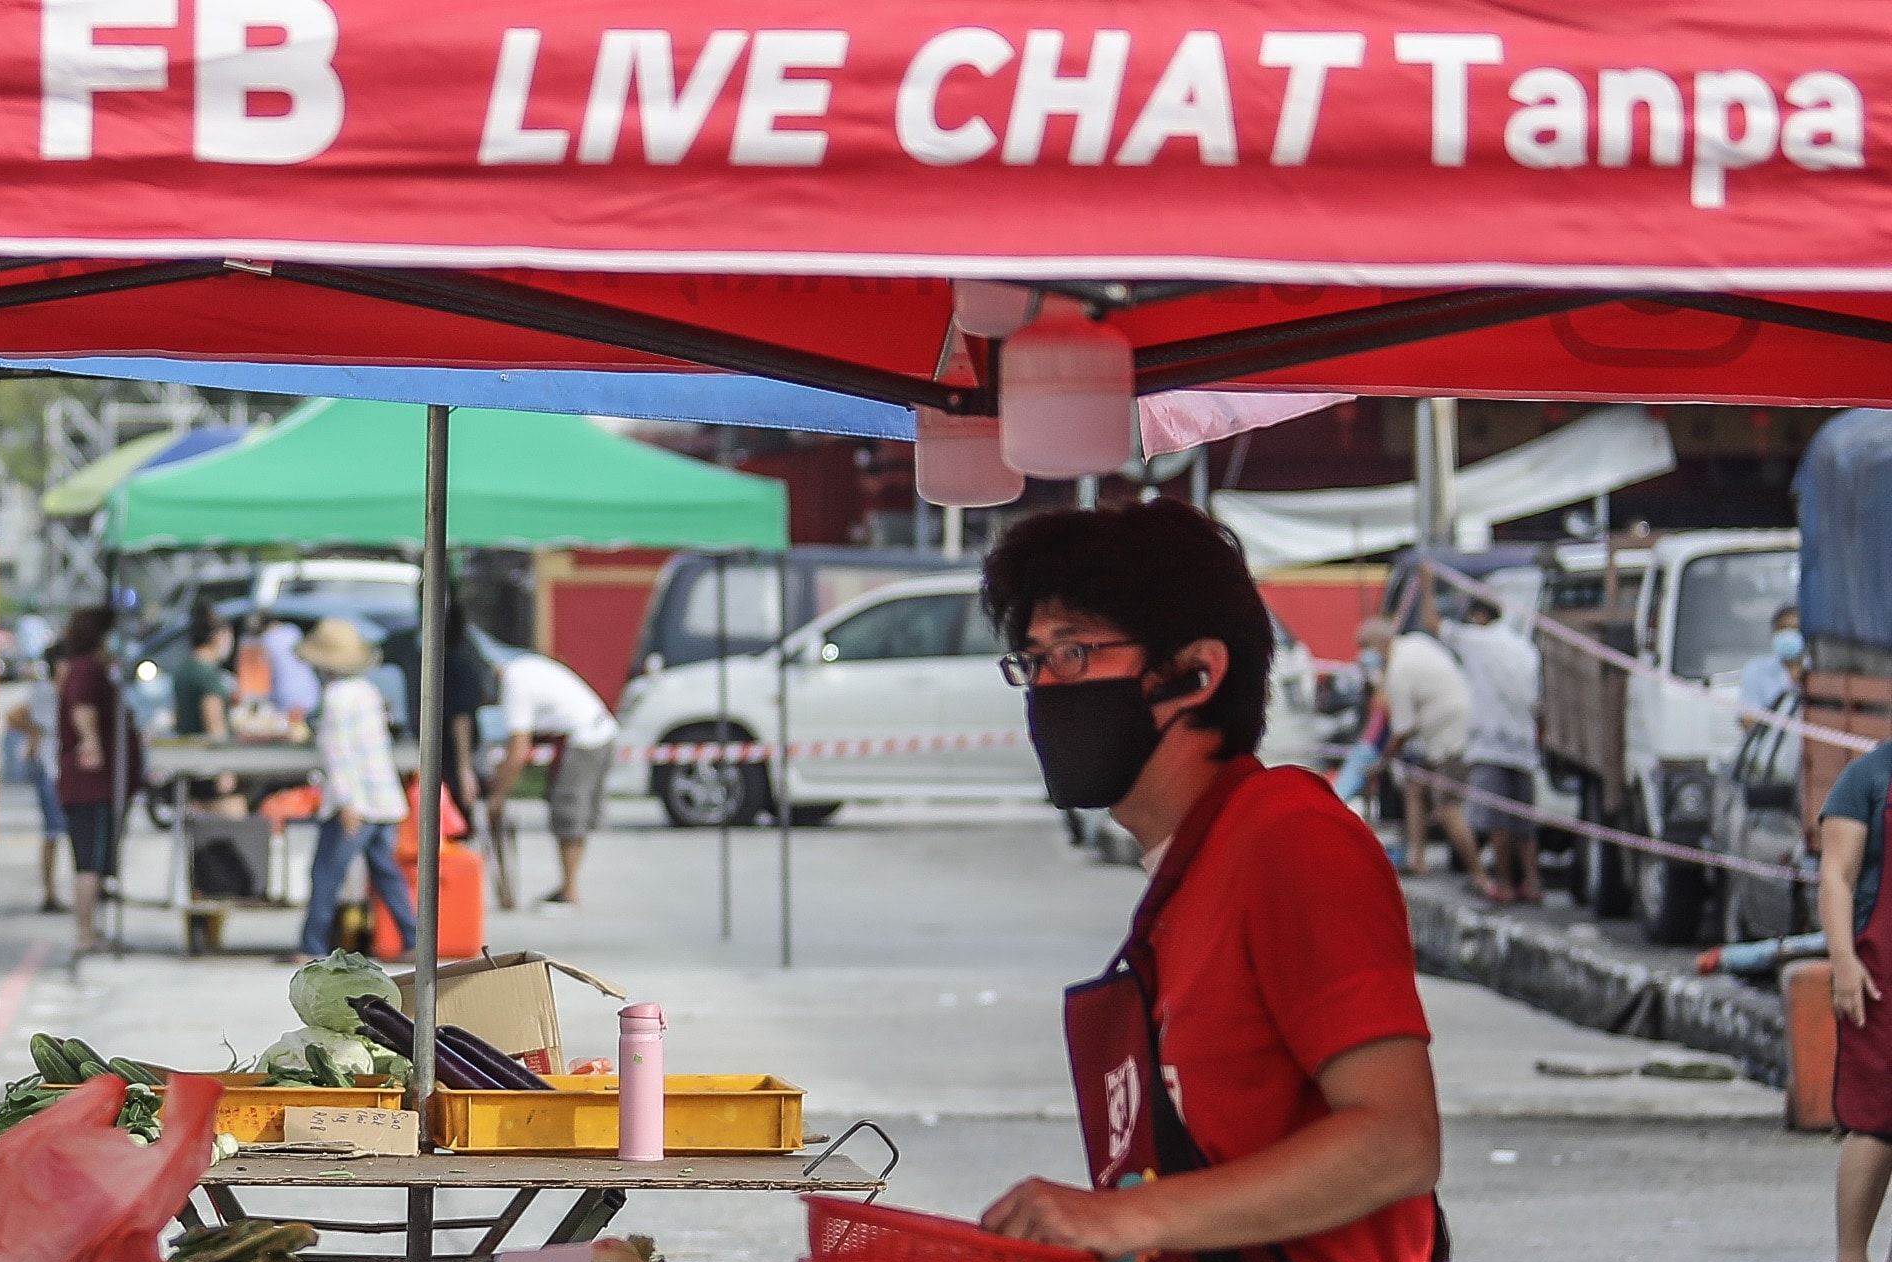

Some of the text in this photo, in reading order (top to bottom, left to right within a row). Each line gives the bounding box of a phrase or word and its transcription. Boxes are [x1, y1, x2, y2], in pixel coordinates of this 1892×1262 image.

[40, 0, 345, 166] FB
[477, 27, 850, 166] LIVE
[894, 26, 1367, 166] CHAT
[1393, 32, 1866, 209] Tanpa
